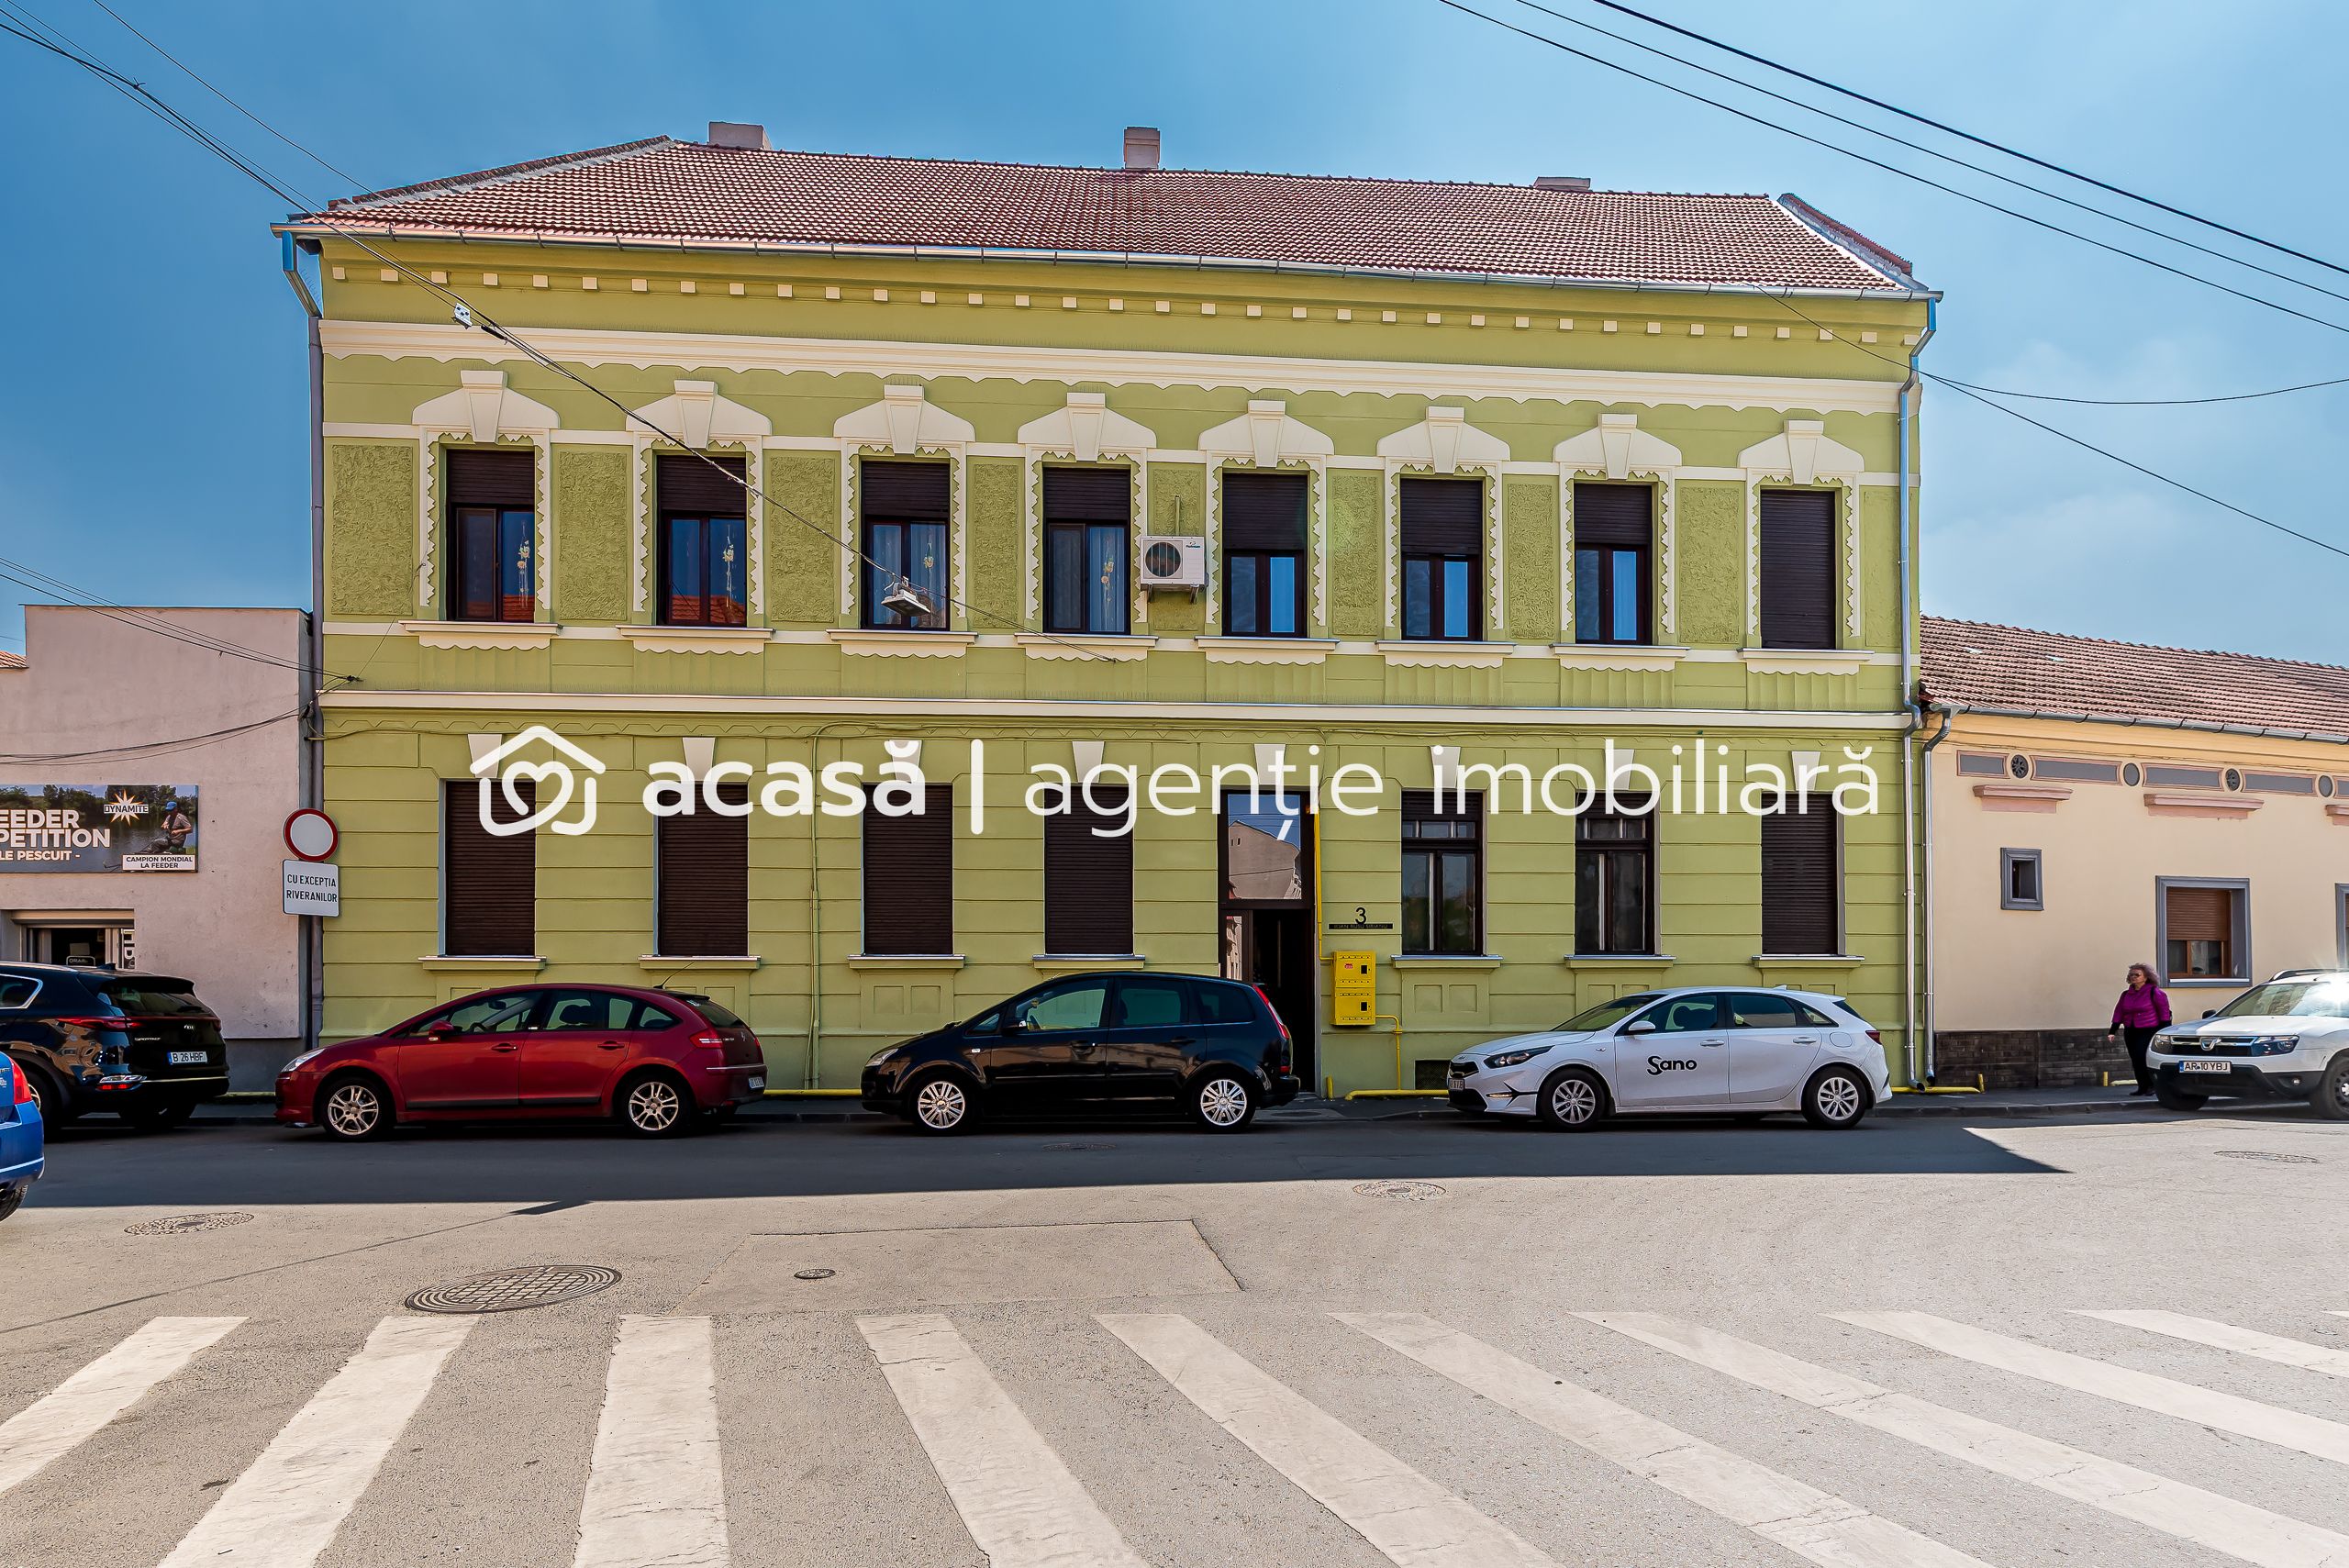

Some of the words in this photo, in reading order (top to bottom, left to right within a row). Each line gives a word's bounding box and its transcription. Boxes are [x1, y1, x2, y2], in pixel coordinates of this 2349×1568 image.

[104, 805, 149, 813] DYNAMITE
[17, 851, 72, 861] PESCUIT
[287, 873, 298, 884] CU
[286, 889, 338, 903] RIVERANILOR
[1355, 906, 1367, 925] 3
[173, 1052, 179, 1062] B
[180, 1052, 189, 1062] 26
[190, 1052, 204, 1062] HBF
[1647, 1055, 1698, 1076] Sano
[2184, 1062, 2198, 1071] AR
[2199, 1062, 2209, 1071] 10
[2210, 1062, 2228, 1071] YBJ
